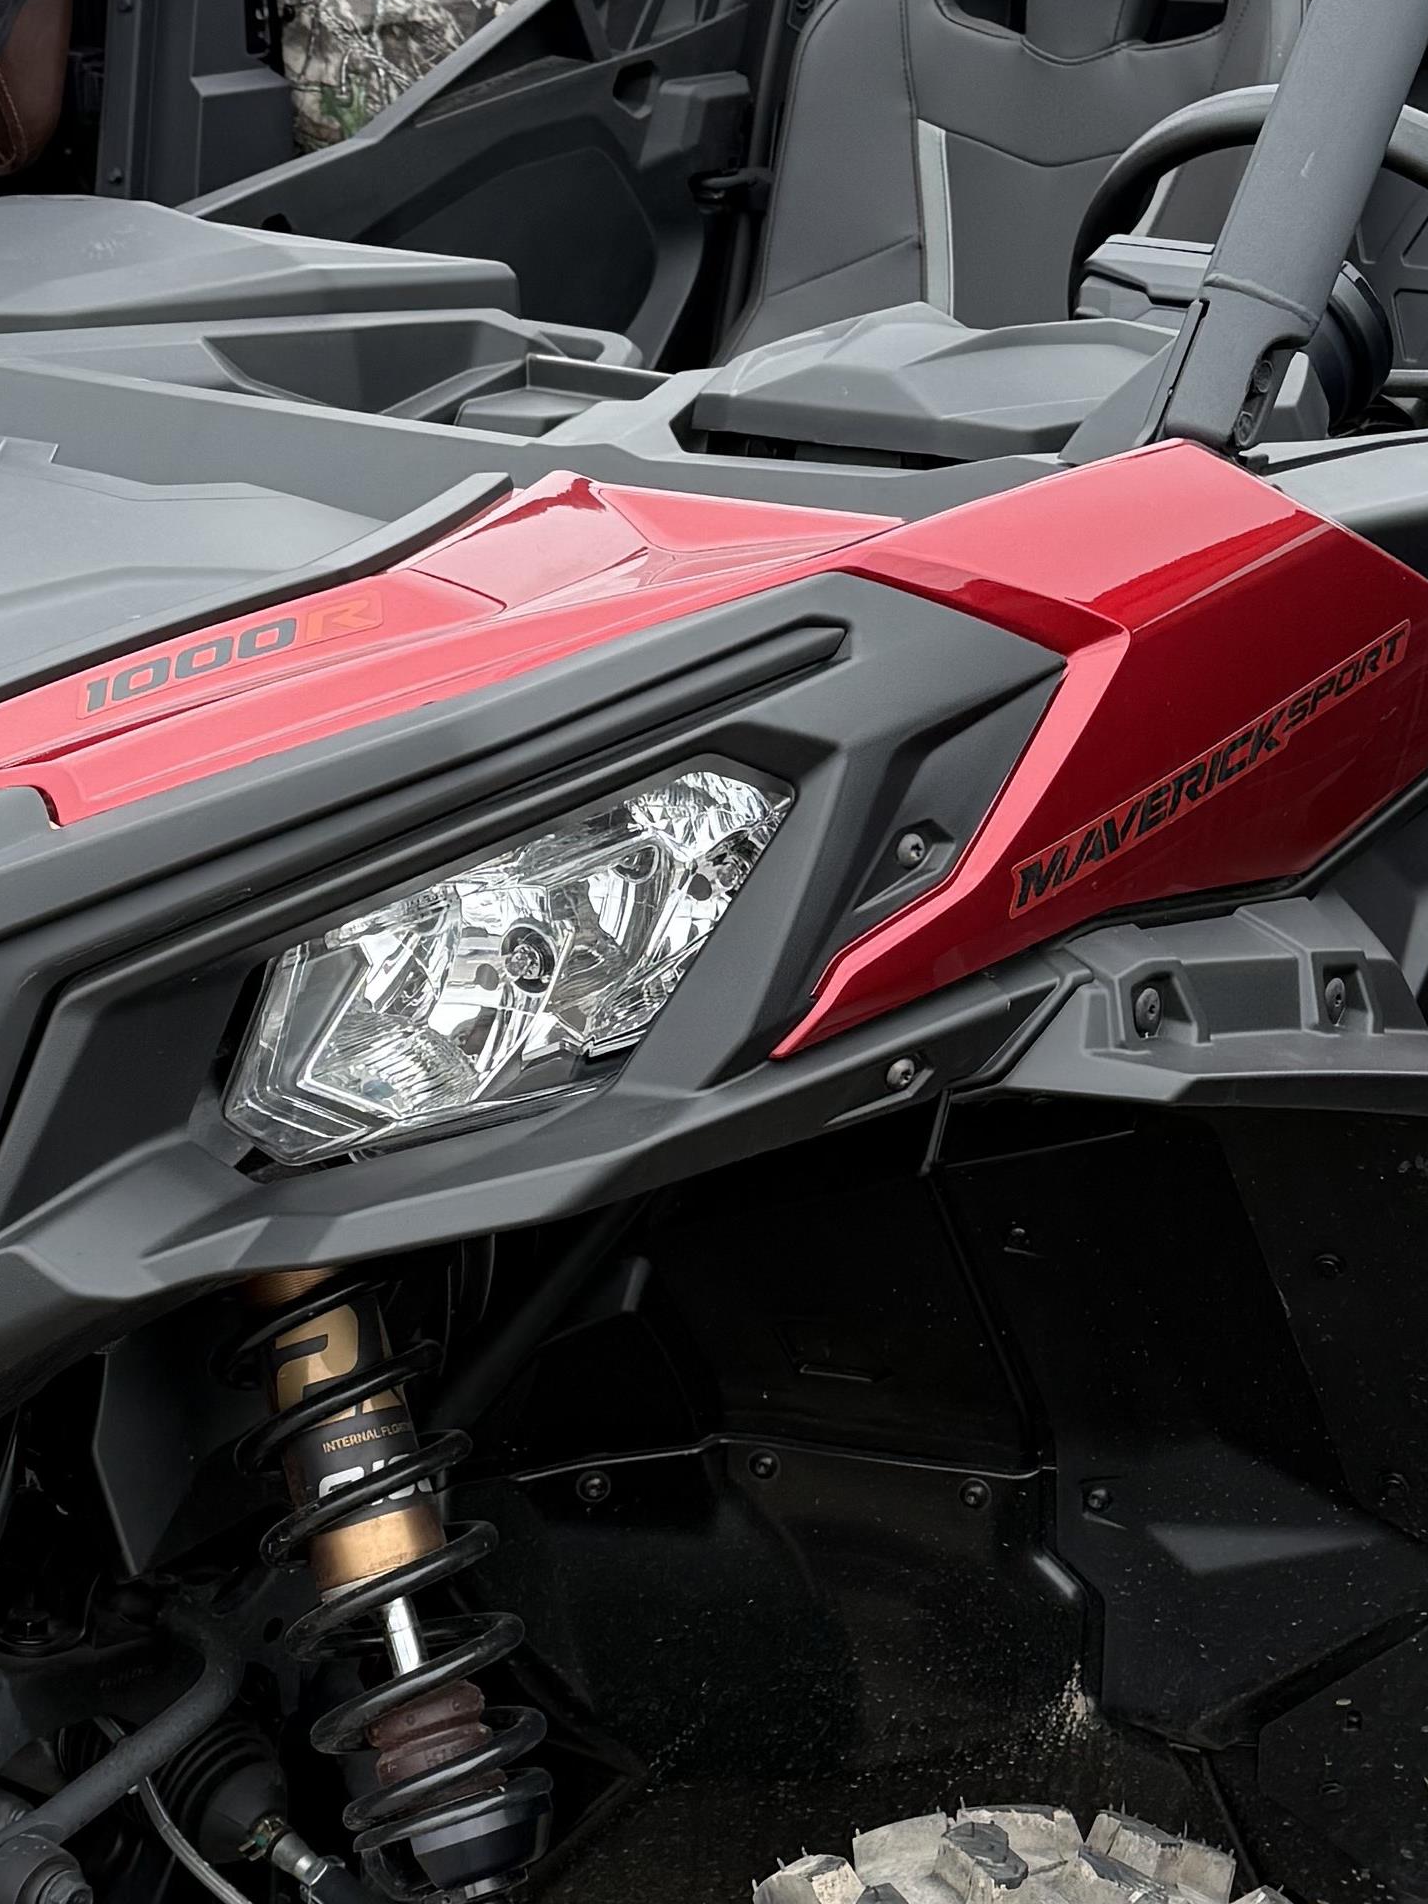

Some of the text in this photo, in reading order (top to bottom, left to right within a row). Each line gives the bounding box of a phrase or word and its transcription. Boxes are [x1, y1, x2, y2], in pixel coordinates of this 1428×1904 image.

[87, 598, 370, 713] 1000R
[1017, 630, 1406, 909] MAVERICK SPORT
[322, 1429, 381, 1453] INTERNAL
